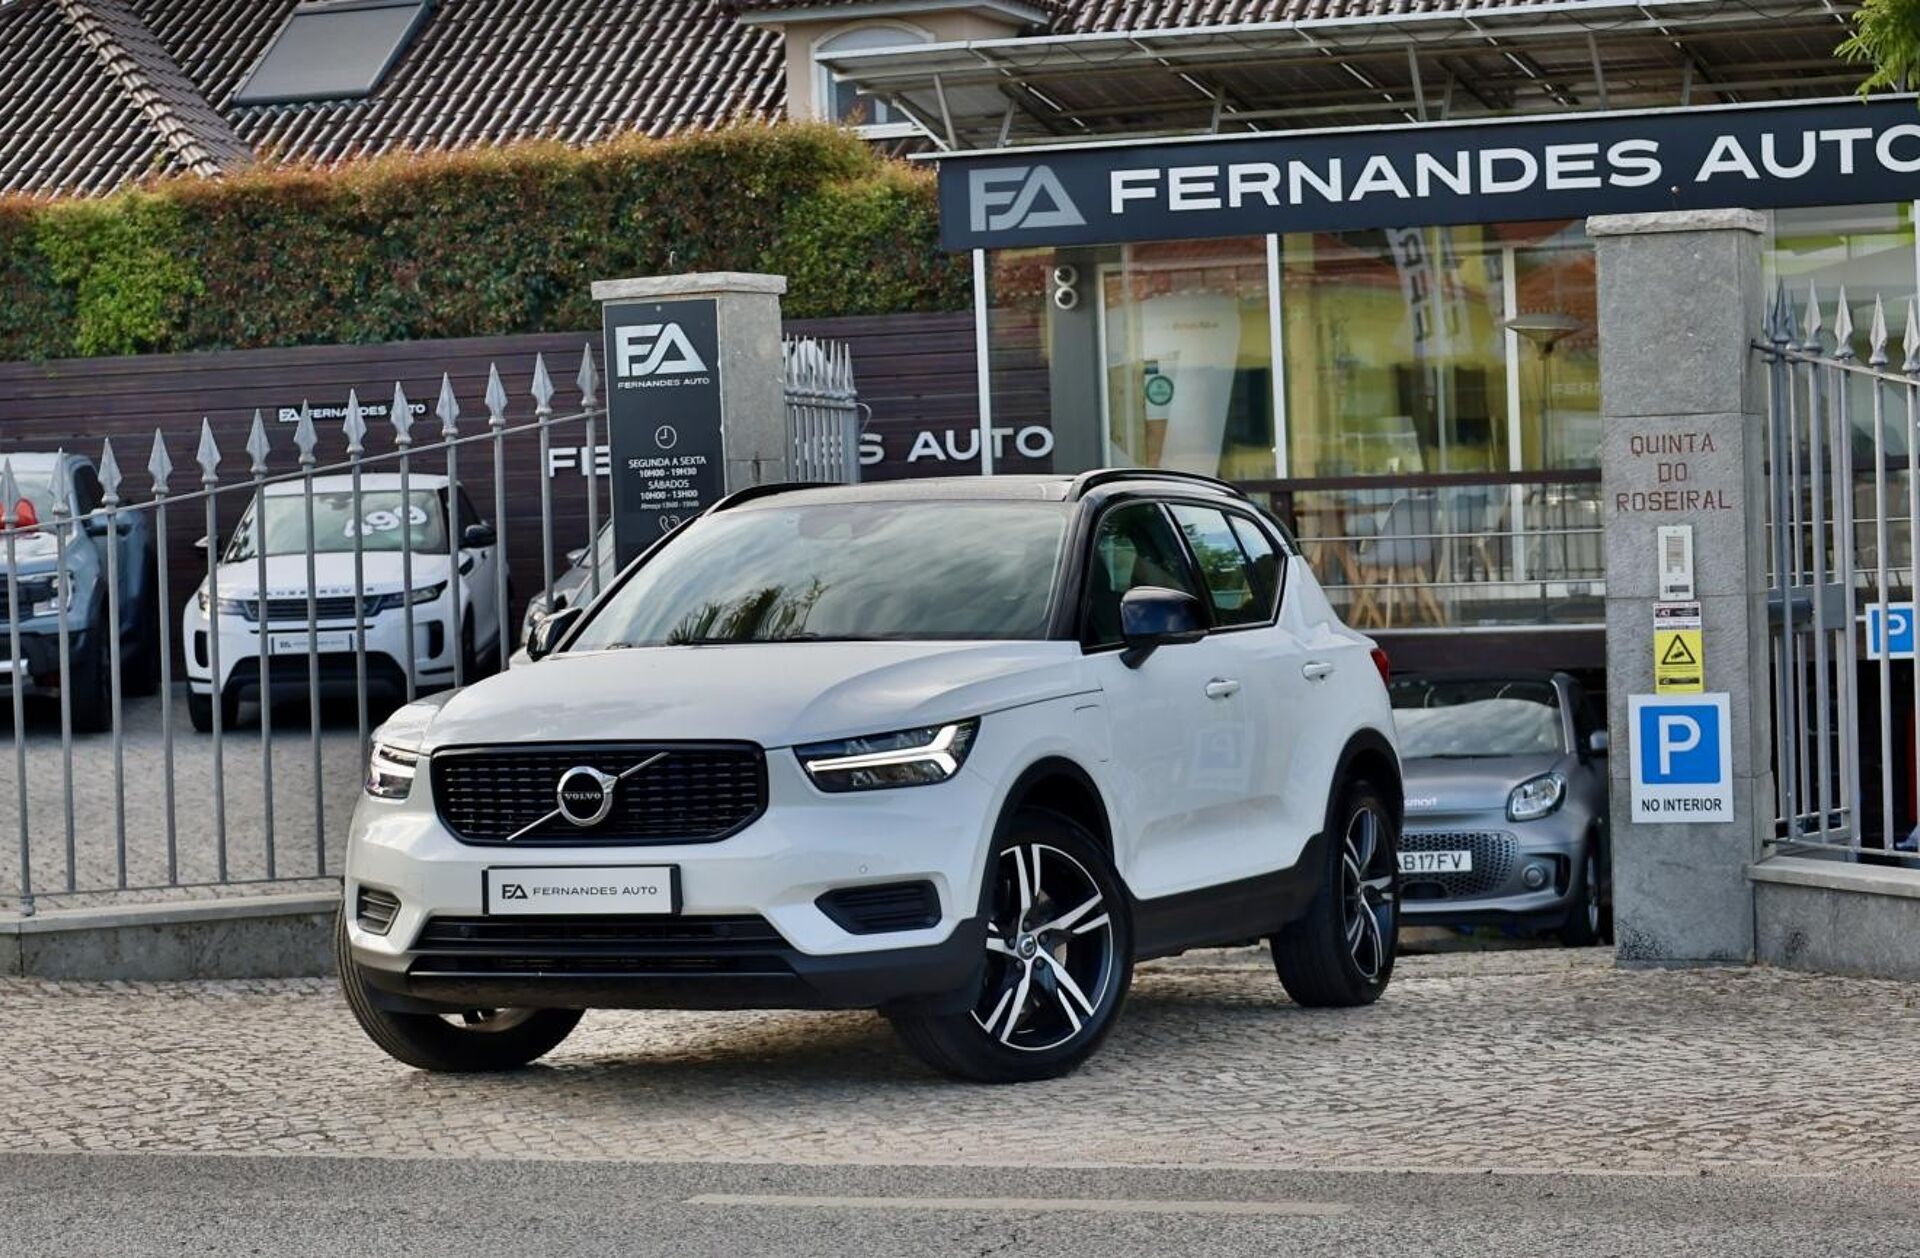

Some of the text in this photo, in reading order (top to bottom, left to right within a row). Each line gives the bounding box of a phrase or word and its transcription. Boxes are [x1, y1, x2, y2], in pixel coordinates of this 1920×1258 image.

[968, 123, 1920, 233] FA FERNANDES AUTO
[615, 322, 709, 377] FA
[617, 377, 710, 389] FERNANDES AUTO
[308, 405, 387, 418] FERNADES
[907, 425, 1054, 463] AUTO
[1630, 432, 1715, 457] QUINTA
[628, 456, 707, 469] SEGUNDA A SEXTA
[1657, 461, 1688, 483] DO
[648, 479, 690, 490] SÁBADOS
[1616, 489, 1732, 512] ROSEIRAL
[1658, 714, 1701, 775] P
[564, 792, 602, 800] VOLVO
[1642, 798, 1722, 812] NO INTERIOR
[1396, 853, 1462, 871] B17FV
[501, 883, 657, 899] FA FERNANDES AUTO
